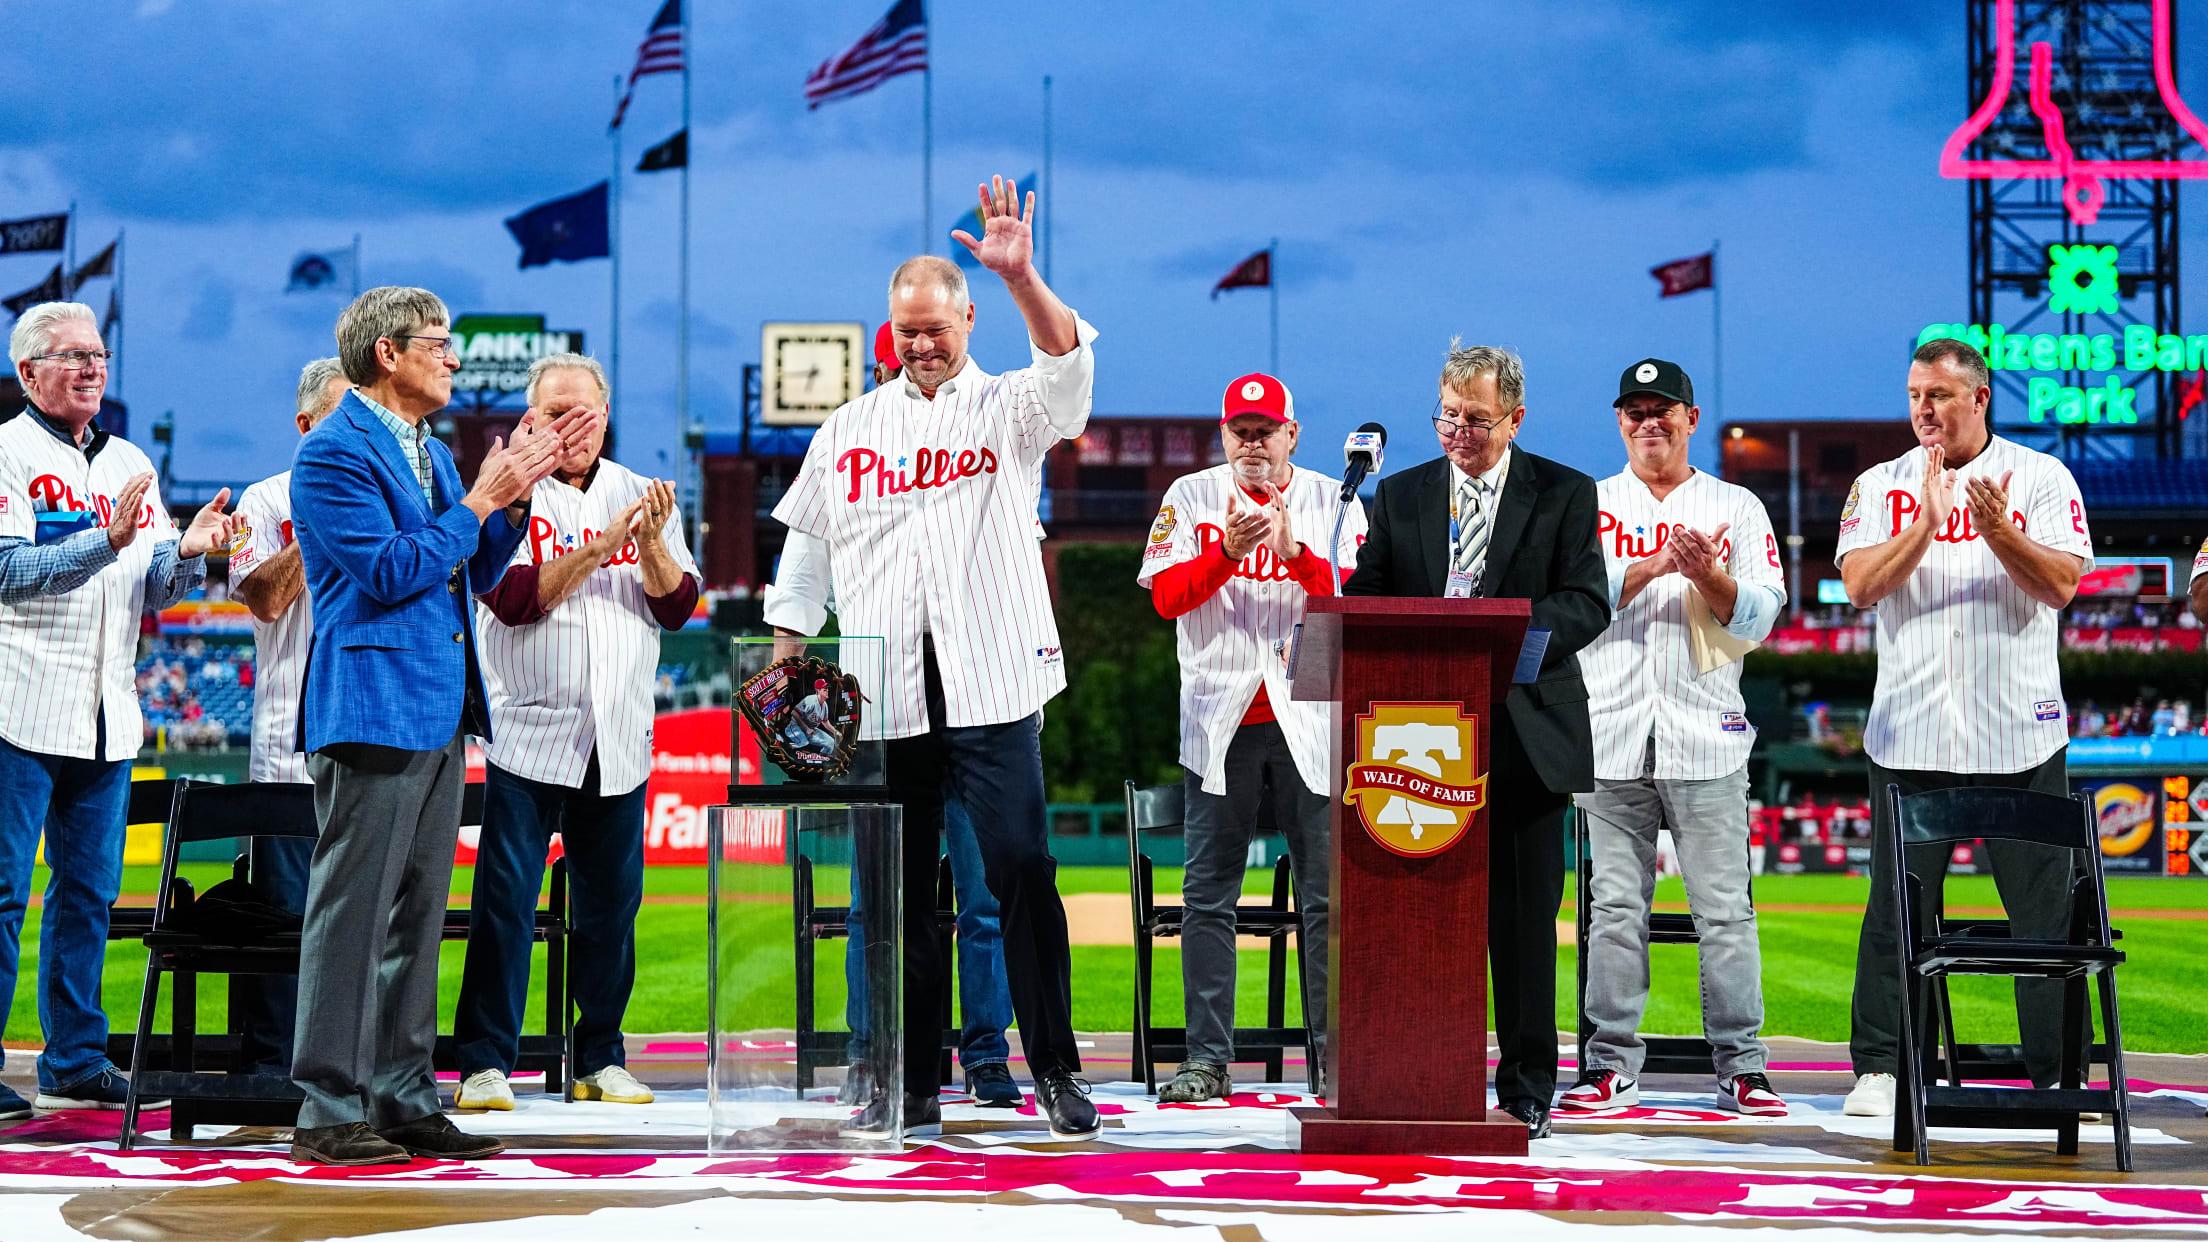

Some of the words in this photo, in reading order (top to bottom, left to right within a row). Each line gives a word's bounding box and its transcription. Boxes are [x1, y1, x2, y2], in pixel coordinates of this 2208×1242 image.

[2028, 375, 2137, 424] Park
[836, 446, 998, 504] Phillies
[747, 677, 767, 698] SCOTT
[766, 668, 785, 685] ROLEN
[1362, 770, 1405, 787] WALL
[1408, 778, 1431, 794] OF
[1432, 785, 1477, 802] FAME
